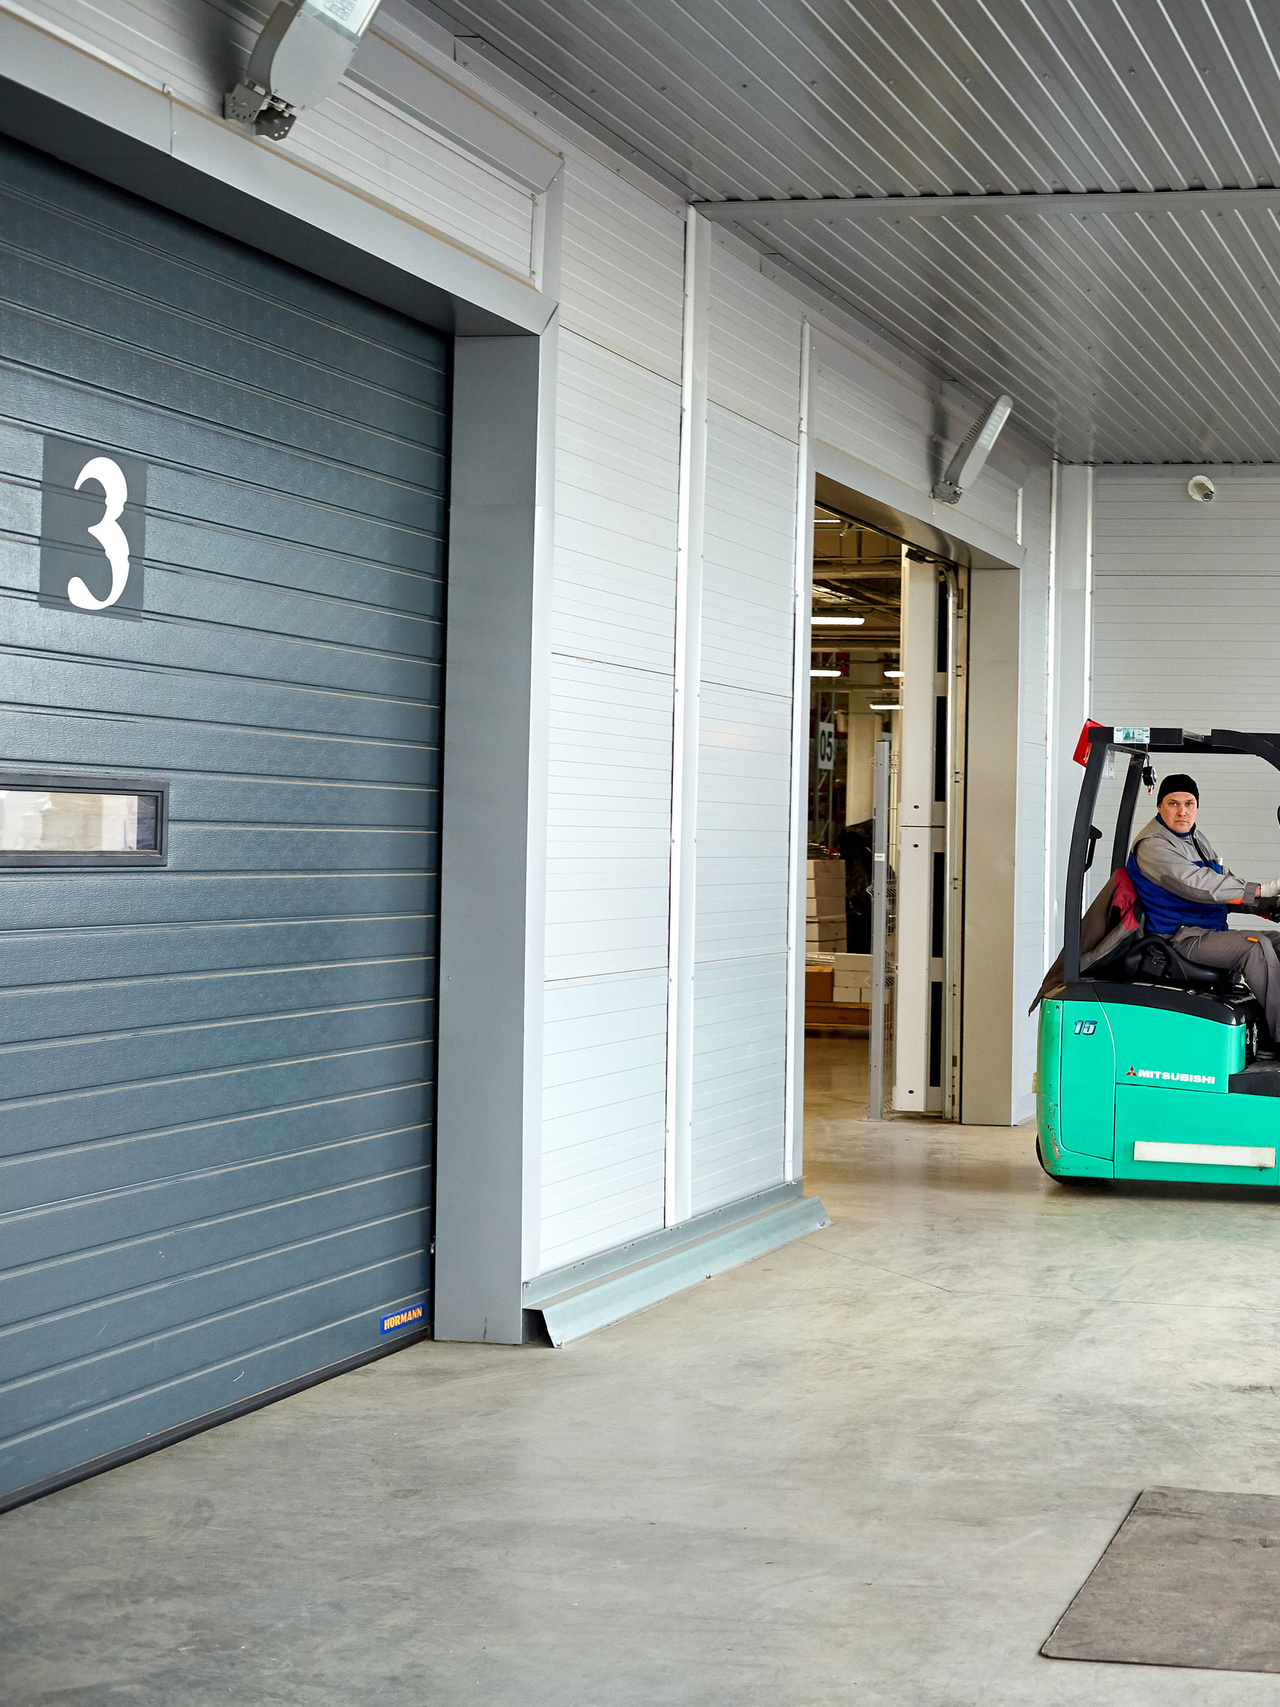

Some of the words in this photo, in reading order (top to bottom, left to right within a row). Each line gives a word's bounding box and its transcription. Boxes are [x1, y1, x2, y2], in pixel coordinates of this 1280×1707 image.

[67, 456, 130, 610] 3
[820, 730, 833, 762] 05
[1074, 1019, 1097, 1035] 15
[1138, 1069, 1216, 1084] MITSUBISHI
